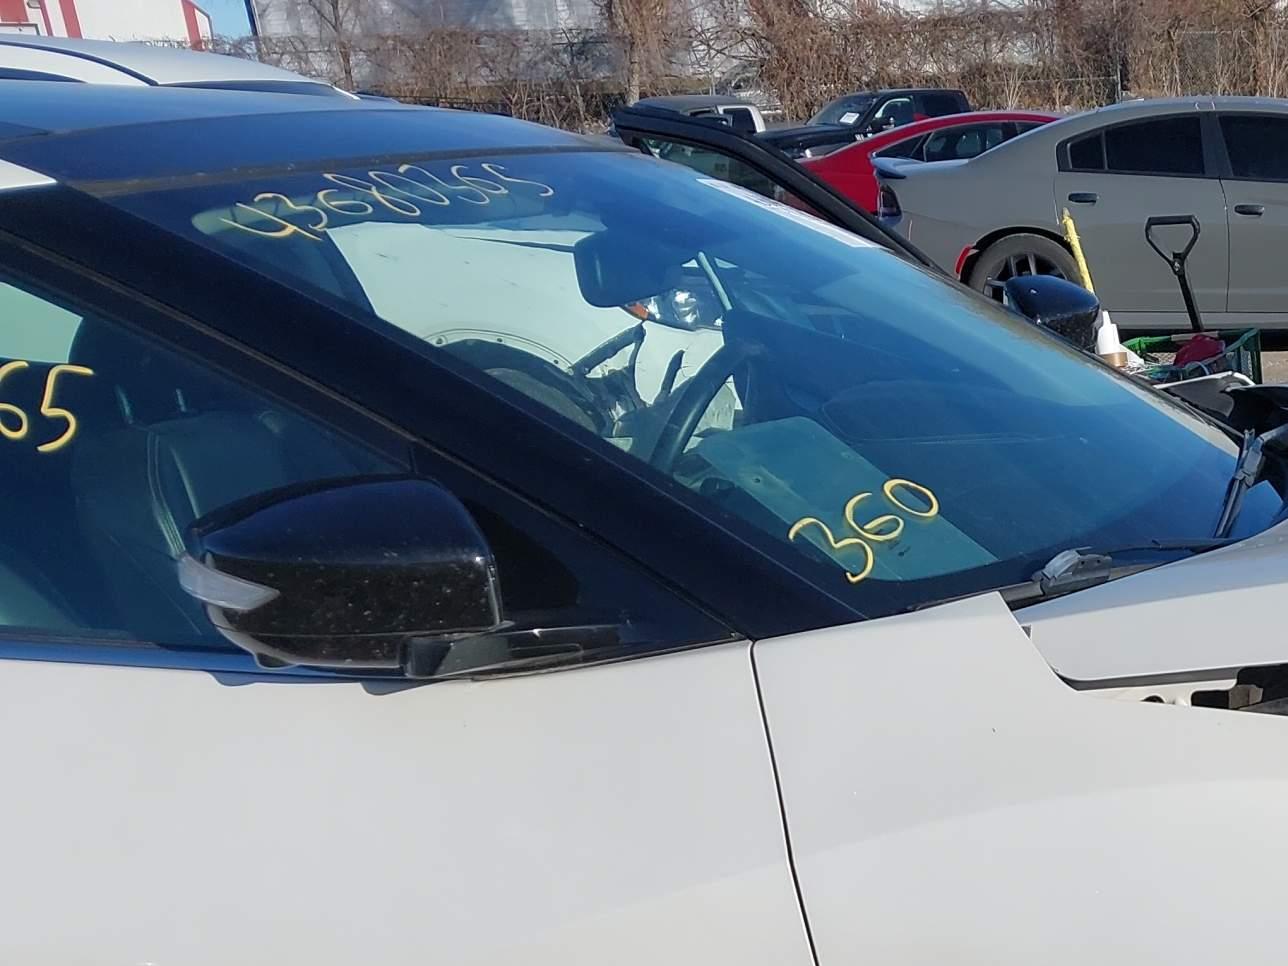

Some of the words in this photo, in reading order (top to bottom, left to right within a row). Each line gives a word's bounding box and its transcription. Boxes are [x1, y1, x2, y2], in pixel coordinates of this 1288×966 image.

[219, 162, 554, 241] 43680365
[0, 360, 95, 452] 65
[788, 478, 940, 584] 360
